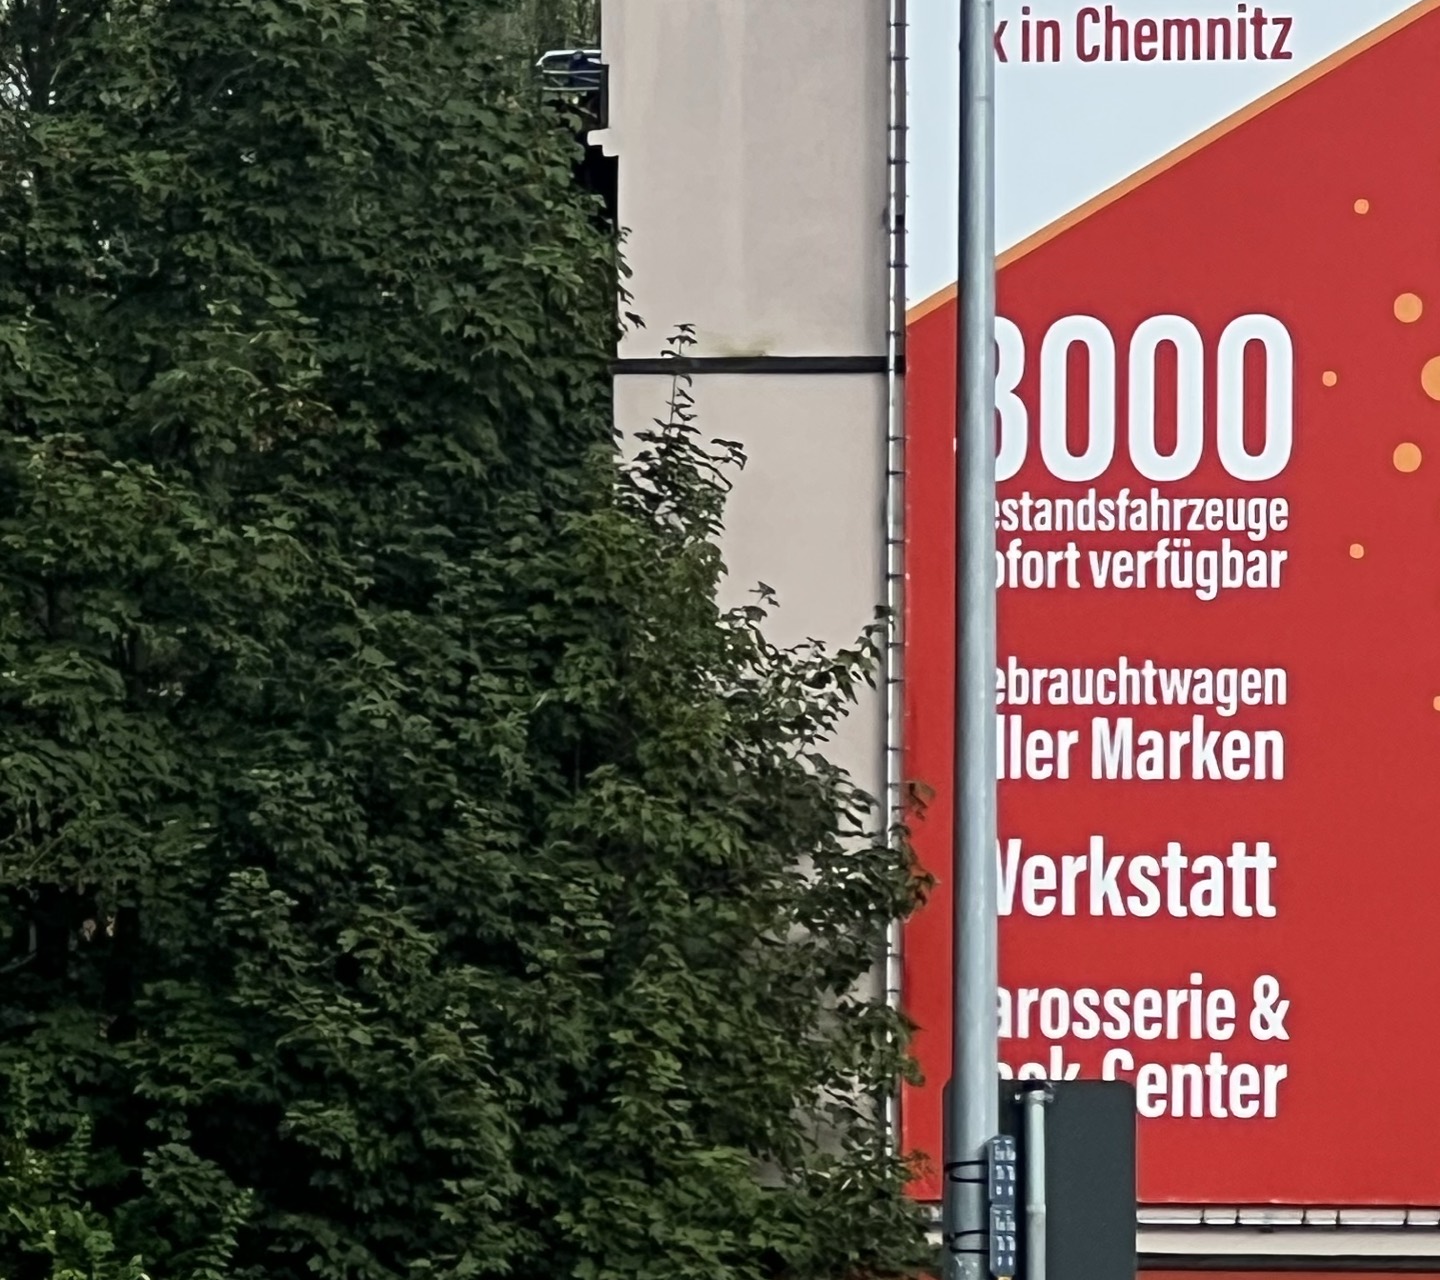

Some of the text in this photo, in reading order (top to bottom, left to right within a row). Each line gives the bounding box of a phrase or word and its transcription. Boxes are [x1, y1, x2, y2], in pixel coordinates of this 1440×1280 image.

[1021, 7, 1061, 62] in
[1076, 4, 1293, 61] Chemnitz
[1089, 539, 1288, 600] verfügbar
[996, 714, 1284, 780] ller Marken
[997, 972, 1290, 1040] arosserie &
